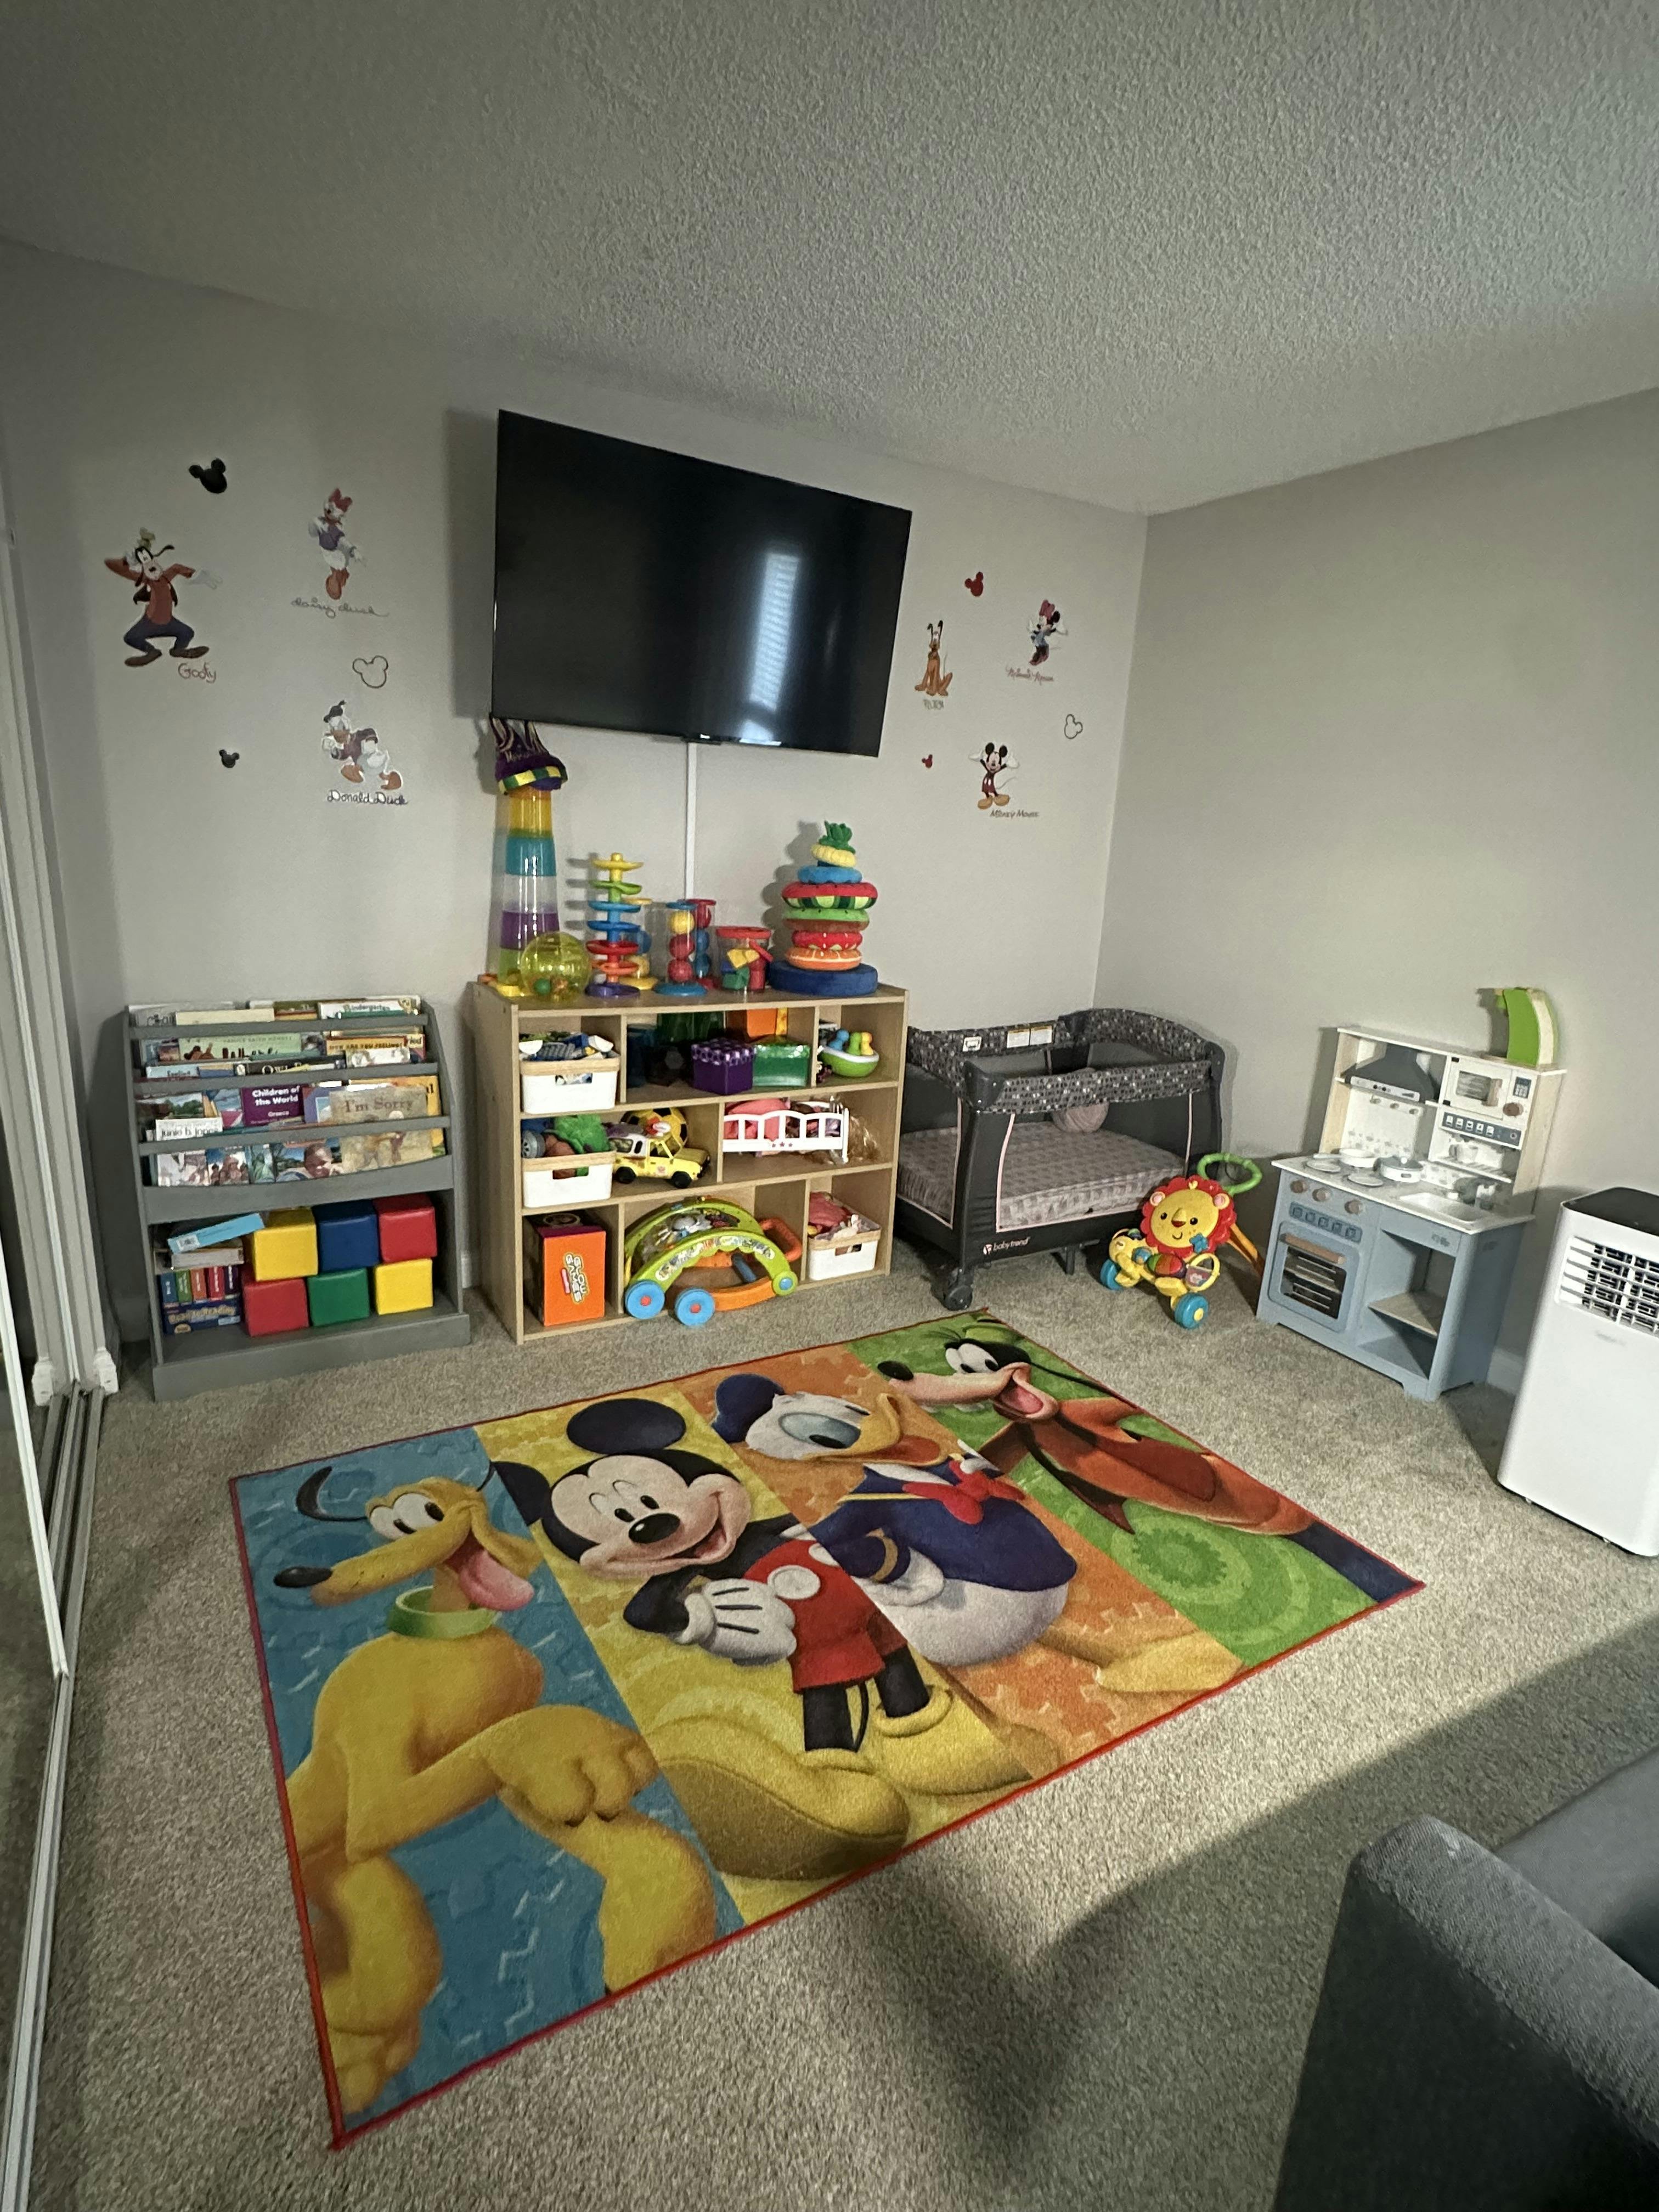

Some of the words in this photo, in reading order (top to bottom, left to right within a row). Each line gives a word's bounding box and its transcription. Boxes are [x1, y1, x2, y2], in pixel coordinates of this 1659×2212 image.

[327, 789, 370, 804] Donald
[252, 1088, 289, 1097] Children
[291, 1085, 301, 1093] of
[273, 1094, 298, 1104] World
[345, 1099, 369, 1113] I'm
[374, 1096, 413, 1111] Sorry
[565, 1254, 583, 1302] GAMES
[573, 1256, 587, 1294] GLOW
